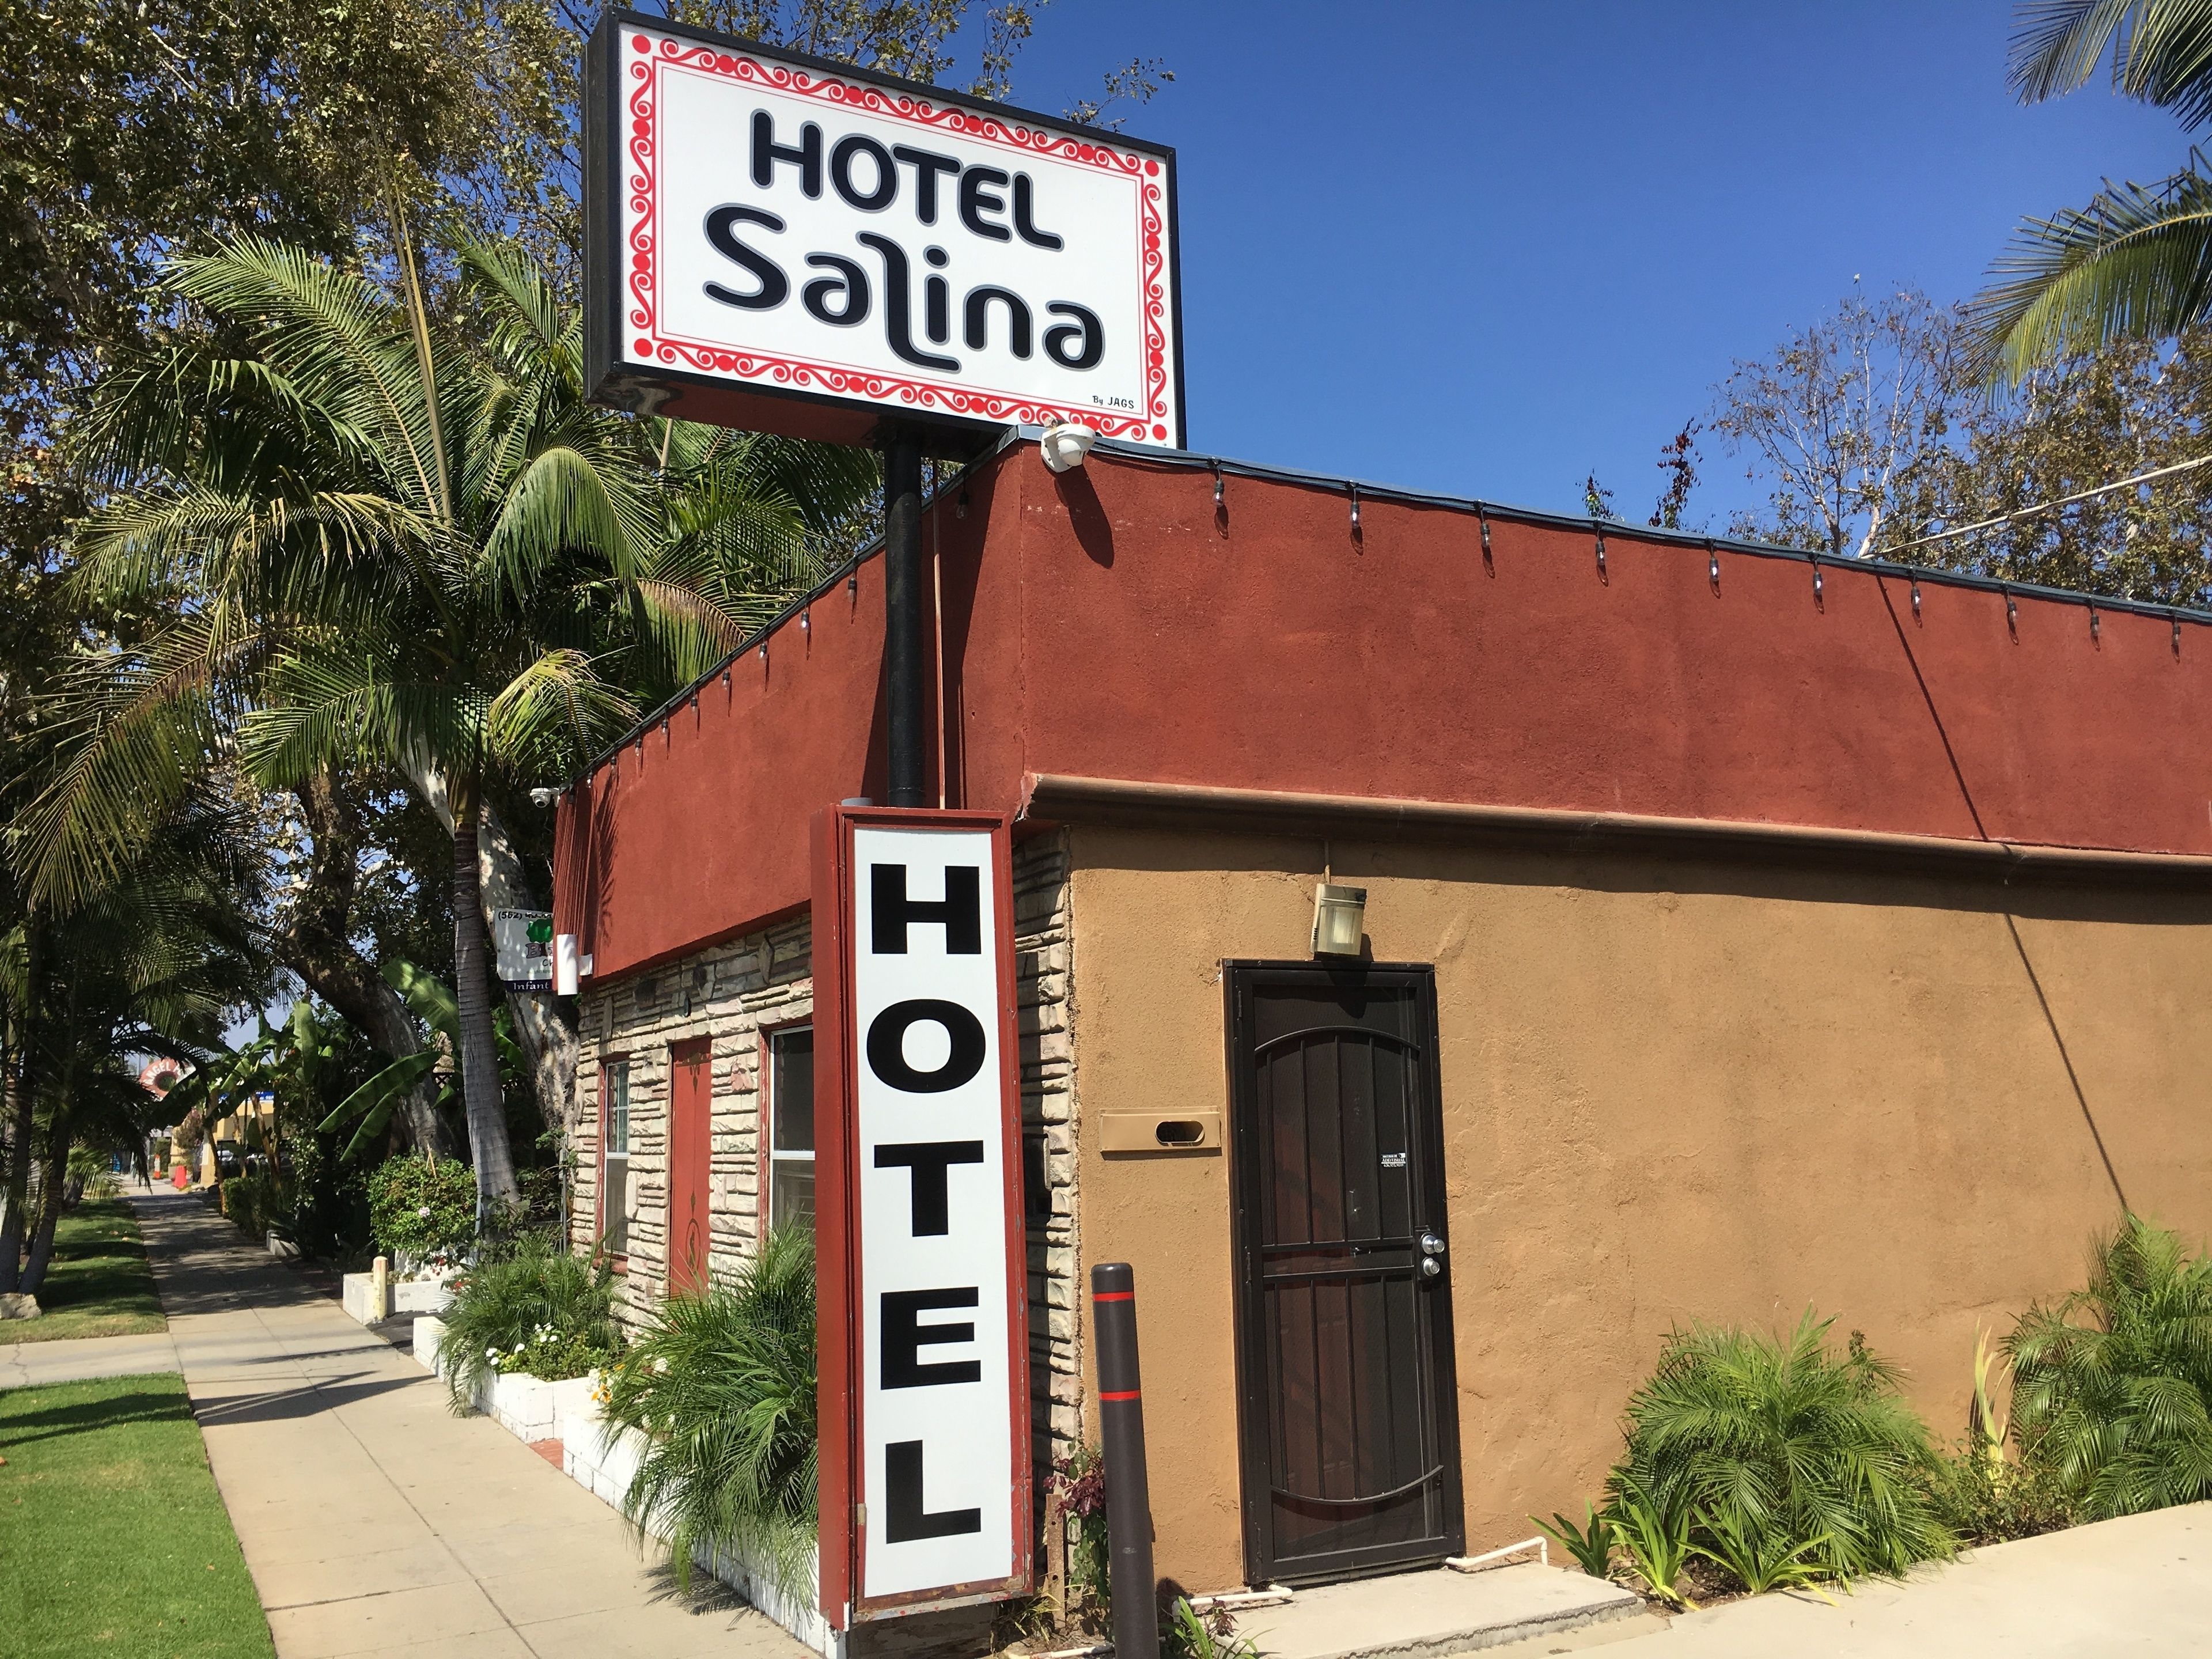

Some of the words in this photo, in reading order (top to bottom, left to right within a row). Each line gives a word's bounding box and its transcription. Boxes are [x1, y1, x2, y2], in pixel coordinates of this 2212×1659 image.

[751, 109, 1063, 251] HOTEL
[704, 204, 1104, 372] Salina
[1092, 395, 1103, 406] By
[1108, 396, 1134, 409] JAGS
[498, 911, 522, 921] (562)
[513, 981, 549, 990] Infant
[867, 863, 986, 1544] HOTEL
